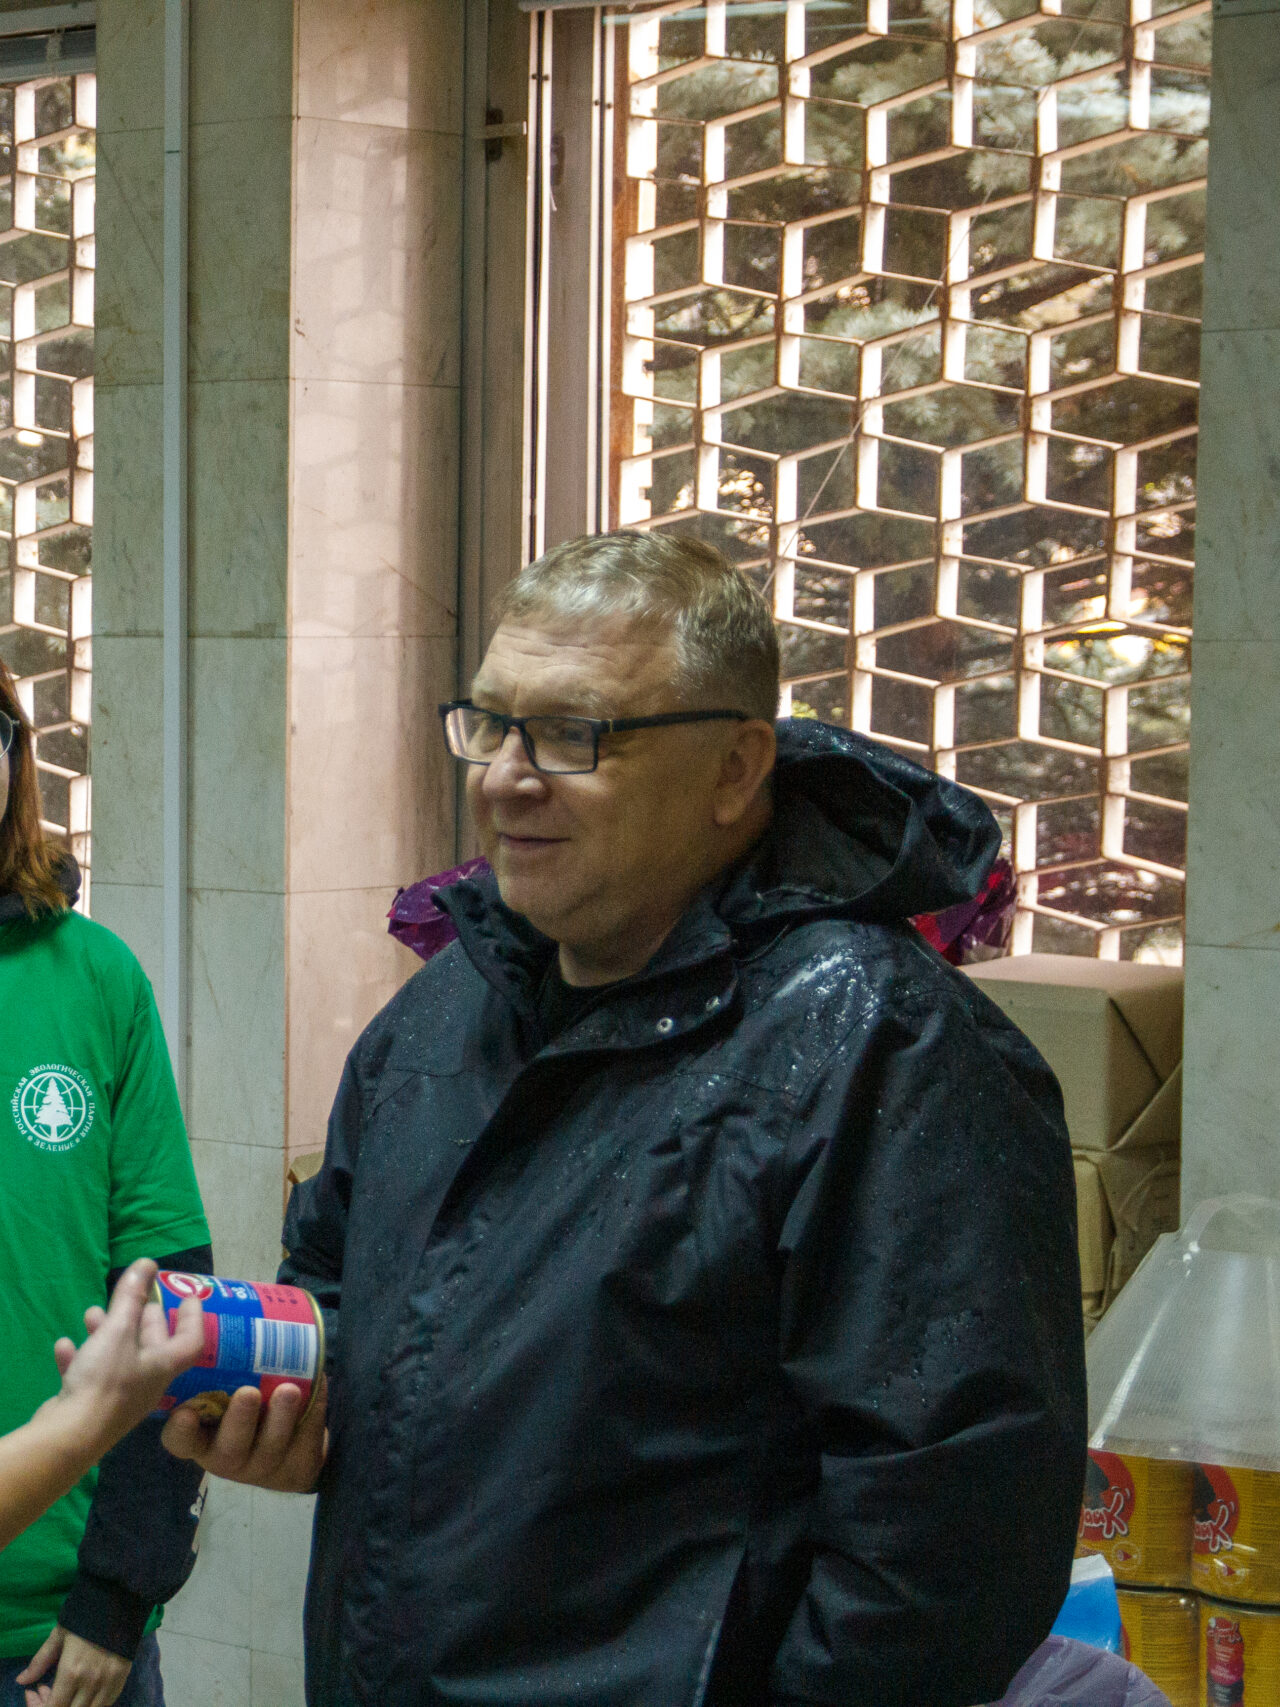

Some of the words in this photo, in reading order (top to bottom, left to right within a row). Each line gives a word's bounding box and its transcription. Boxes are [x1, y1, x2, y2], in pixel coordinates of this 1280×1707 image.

[11, 1077, 28, 1135] РОССИЙСКАЯ
[29, 1063, 93, 1097] ЭКОЛОГИЧЕСКАЯ
[80, 1102, 95, 1138] ПАРТИЯ
